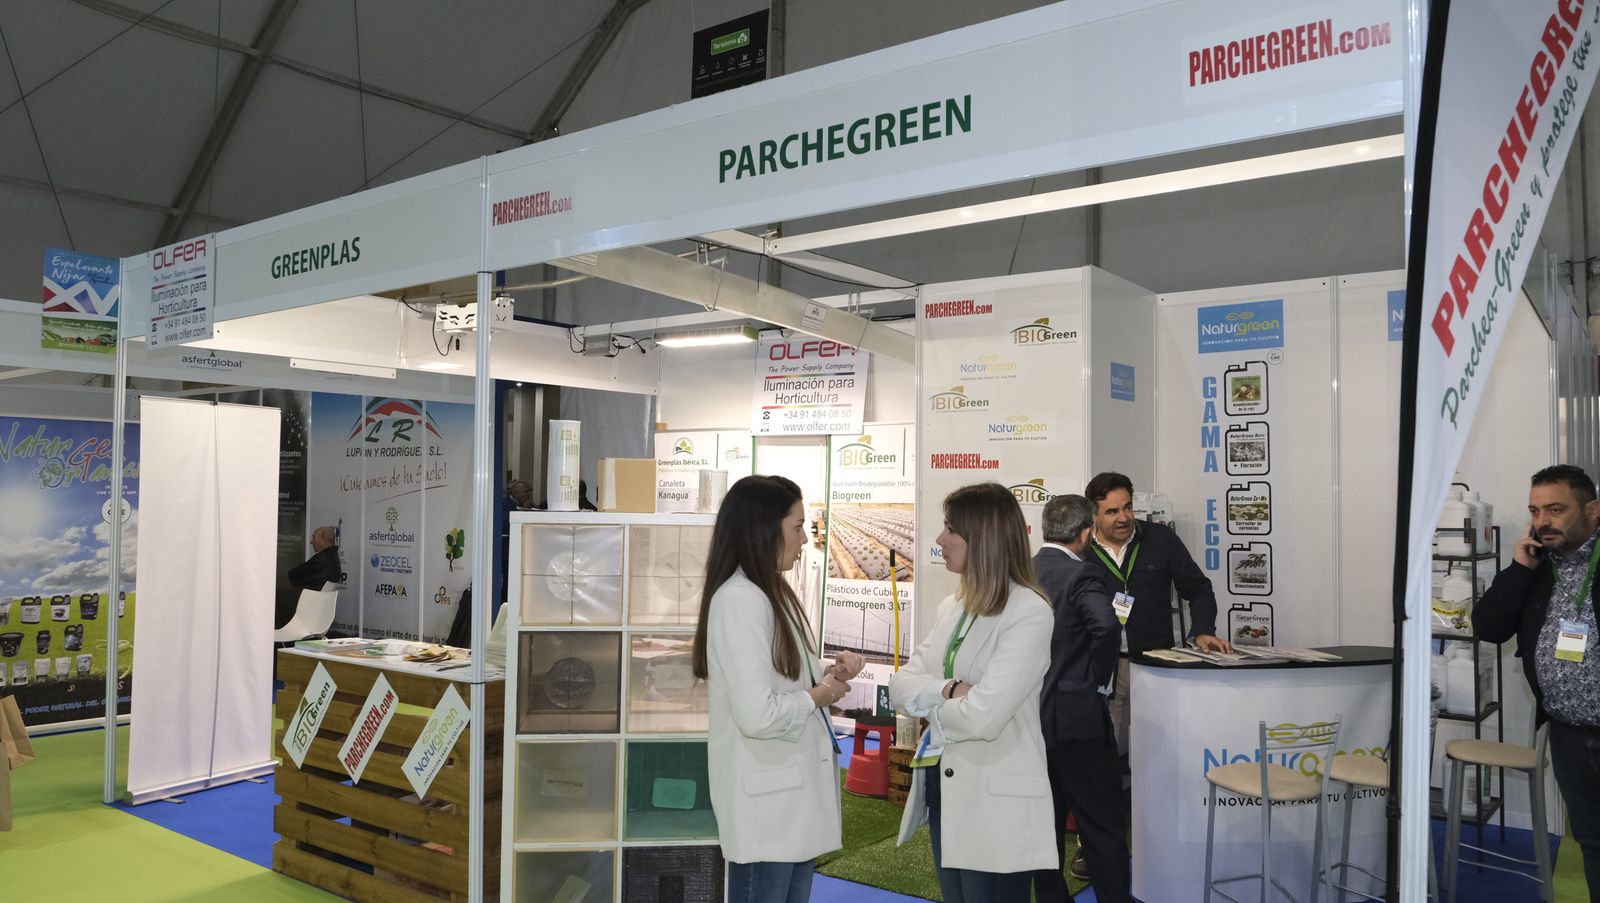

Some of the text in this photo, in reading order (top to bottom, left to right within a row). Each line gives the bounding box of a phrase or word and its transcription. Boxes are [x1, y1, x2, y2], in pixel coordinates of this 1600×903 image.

[713, 38, 736, 49] Tarazona
[720, 94, 971, 183] PARCHEGREEN
[1431, 0, 1584, 358] PARCHEGRE
[271, 236, 360, 279] GREENPLAS
[1441, 203, 1530, 430] Parchea-Green
[1531, 174, 1542, 198] y
[1541, 75, 1577, 177] protege
[52, 256, 113, 274] ExpoLevante
[151, 280, 207, 302] Iluminación para
[158, 298, 198, 315] Horticultura
[175, 319, 181, 327] 91
[182, 318, 191, 326] 484
[192, 316, 198, 324] 08
[199, 313, 206, 322] 50
[1202, 319, 1280, 336] Naturgreen
[164, 327, 206, 342] www.olfer.com
[182, 355, 242, 367] asfertglobal
[960, 362, 1017, 376] Naturgreen
[764, 378, 855, 391] Iluminación para
[775, 392, 838, 404] Horticultura
[784, 409, 852, 419] +34 91 484 08 50
[782, 422, 850, 432] www.olfer.com
[988, 423, 1047, 435] Naturgreen
[1201, 376, 1220, 472] GAMA
[346, 448, 372, 457] LUPIN
[375, 448, 380, 457] Y
[380, 445, 422, 457] RODRÍGUE
[390, 467, 400, 487] de
[659, 480, 685, 488] Canaleta
[658, 492, 689, 501] Kanagua
[832, 491, 871, 501] Biogreen
[369, 531, 414, 543] asfertglobal
[1205, 498, 1219, 570] ECO
[380, 556, 412, 568] ZEOCEL
[827, 584, 859, 595] Plásticos
[861, 586, 871, 596] de
[826, 597, 885, 611] Thermogreen
[370, 629, 385, 637] como
[392, 630, 403, 639] arte
[414, 707, 458, 776] Naturgreen
[1327, 793, 1340, 802] TU
